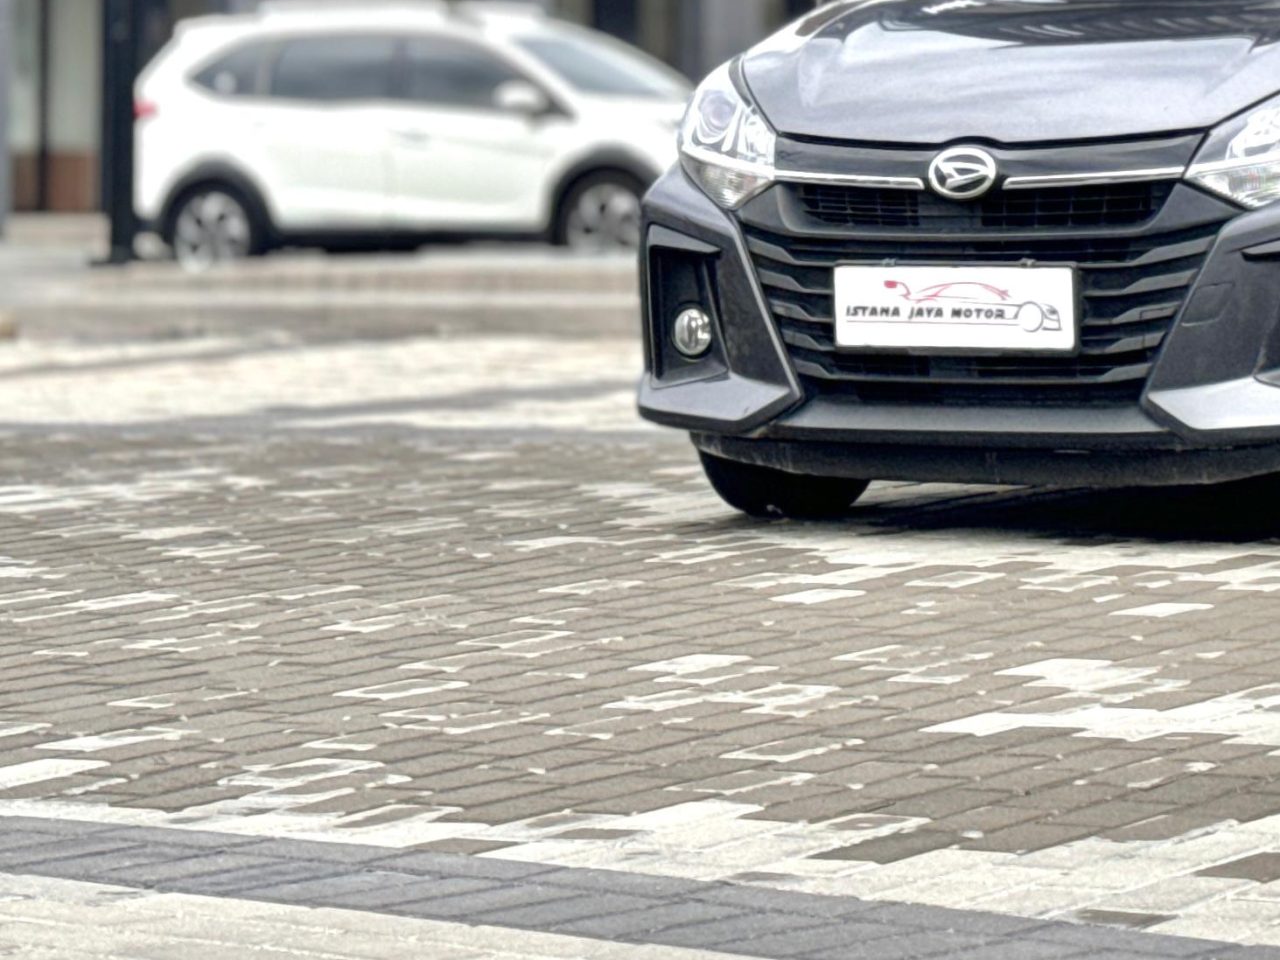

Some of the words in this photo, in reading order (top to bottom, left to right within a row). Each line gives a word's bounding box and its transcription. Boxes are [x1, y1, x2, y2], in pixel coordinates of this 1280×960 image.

[846, 305, 900, 318] ISTANA
[908, 306, 944, 320] JAYA
[951, 307, 1006, 320] MOTOR
